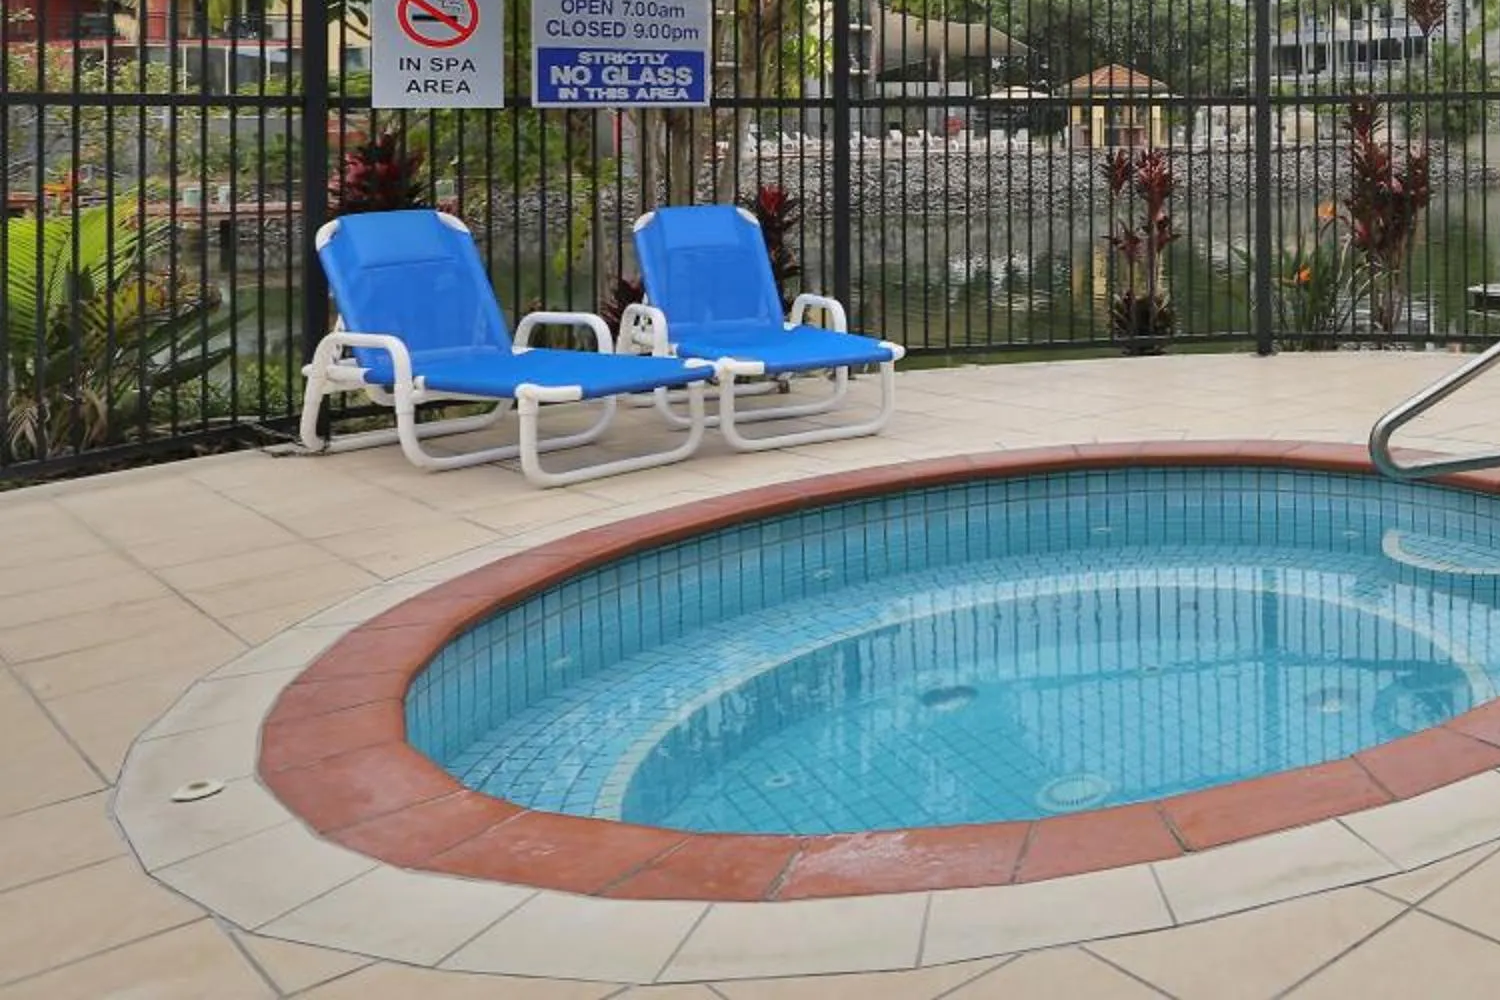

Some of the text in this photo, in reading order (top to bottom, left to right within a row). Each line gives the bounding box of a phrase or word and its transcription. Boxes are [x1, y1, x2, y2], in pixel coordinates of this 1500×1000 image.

[622, 0, 685, 18] 7.00am
[546, 19, 699, 42] CLOSED 9.00pm
[399, 57, 477, 73] IN SPA
[577, 51, 669, 65] STRICTLY
[551, 65, 693, 86] NO GLASS
[406, 79, 472, 94] AREA
[558, 87, 689, 100] IN THIS AREA
